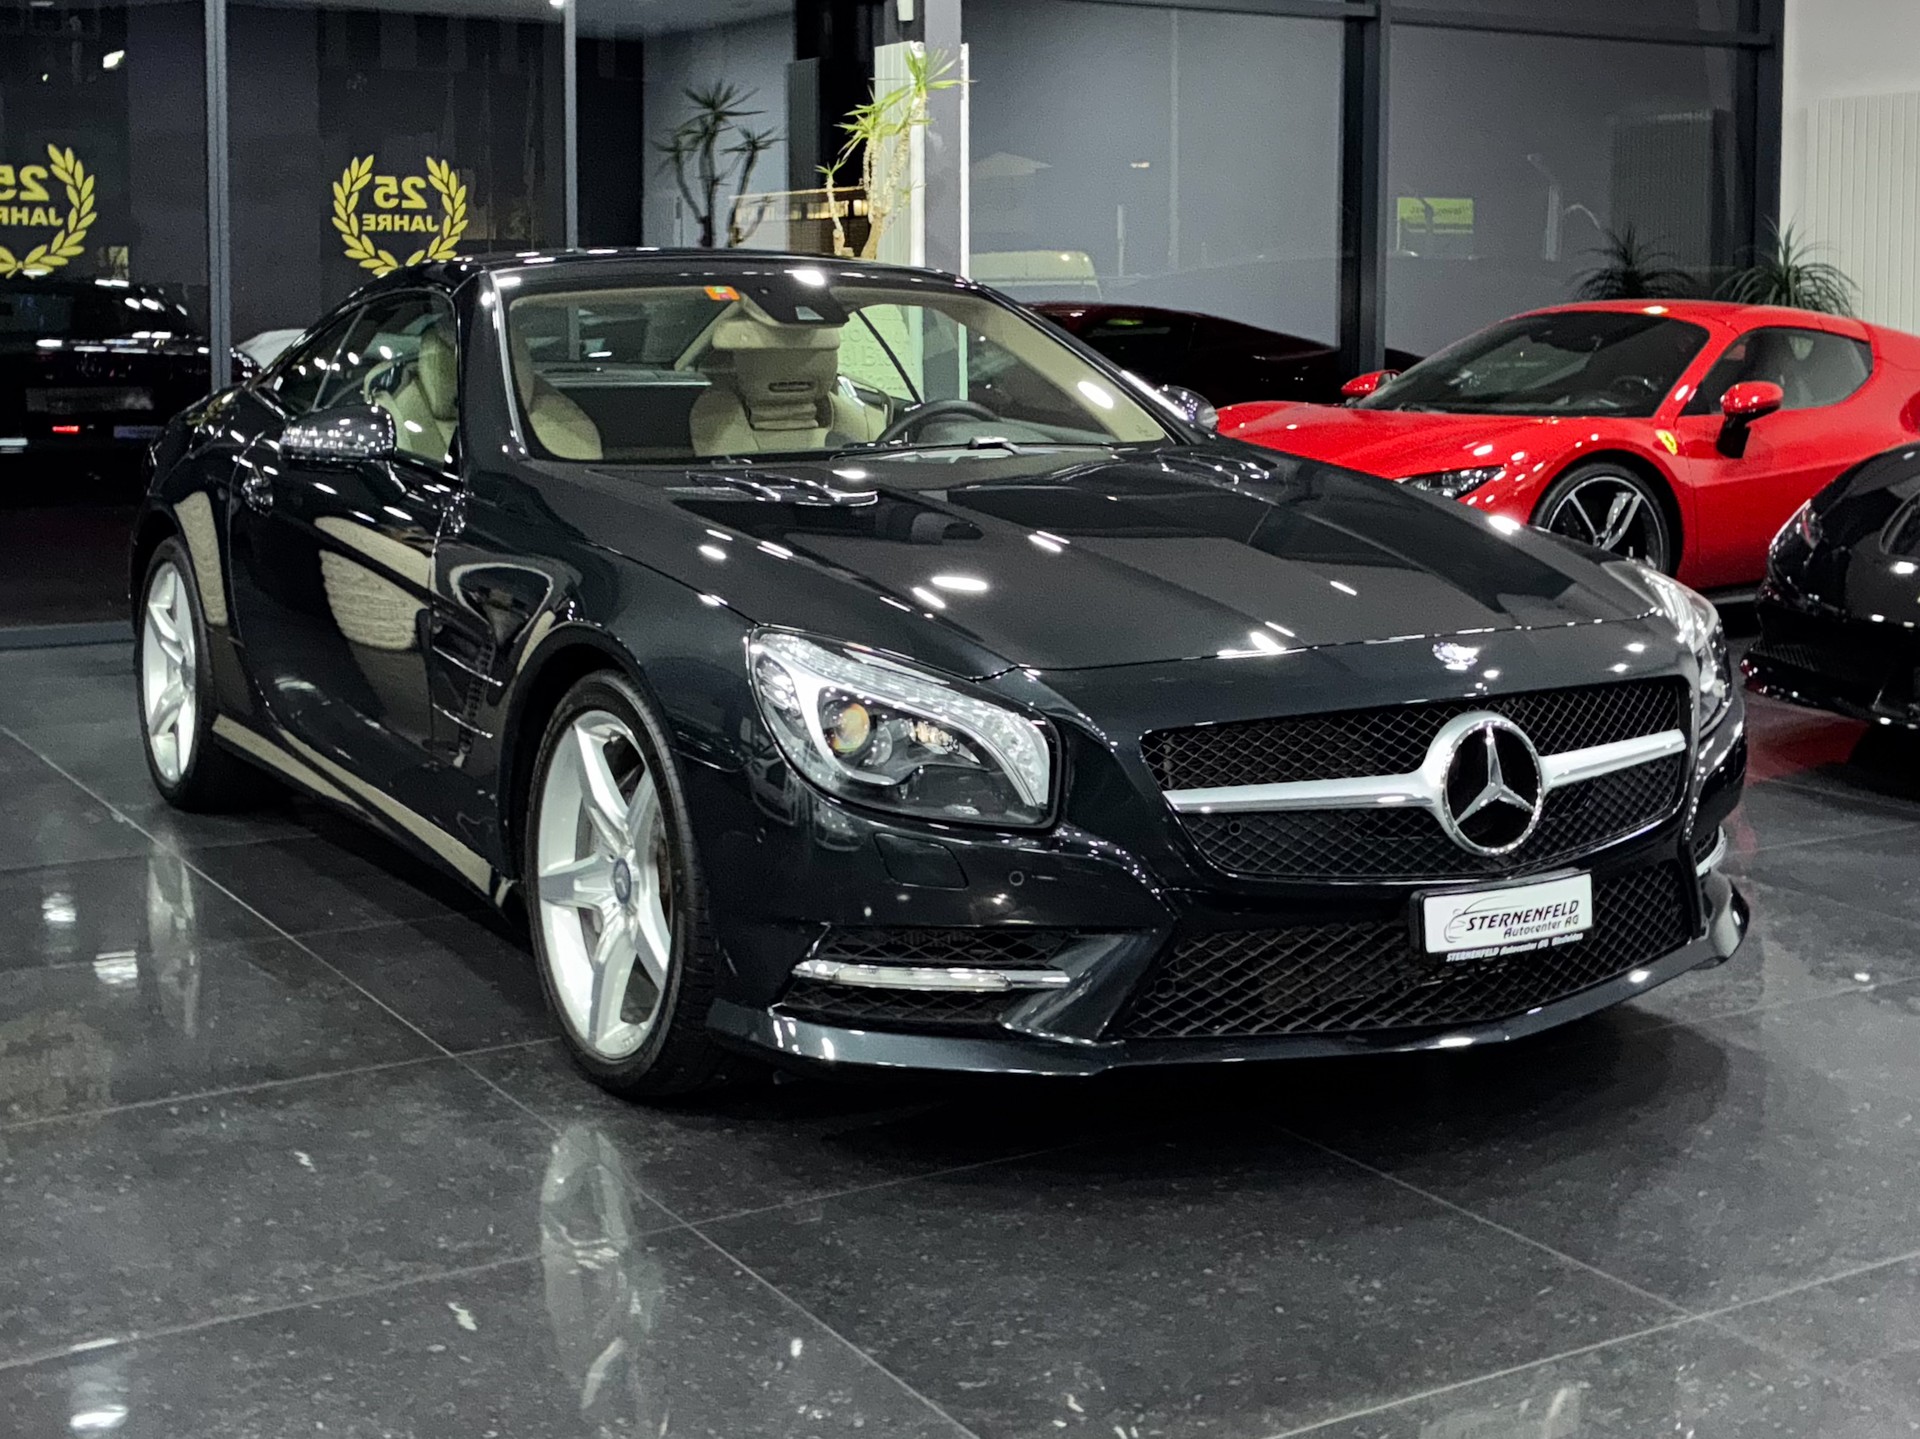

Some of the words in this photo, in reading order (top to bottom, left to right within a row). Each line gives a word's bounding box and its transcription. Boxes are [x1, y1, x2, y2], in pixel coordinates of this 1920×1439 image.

[1466, 900, 1580, 932] STERNENFELD
[1503, 920, 1562, 939] Autocenter
[1564, 914, 1580, 928] AG
